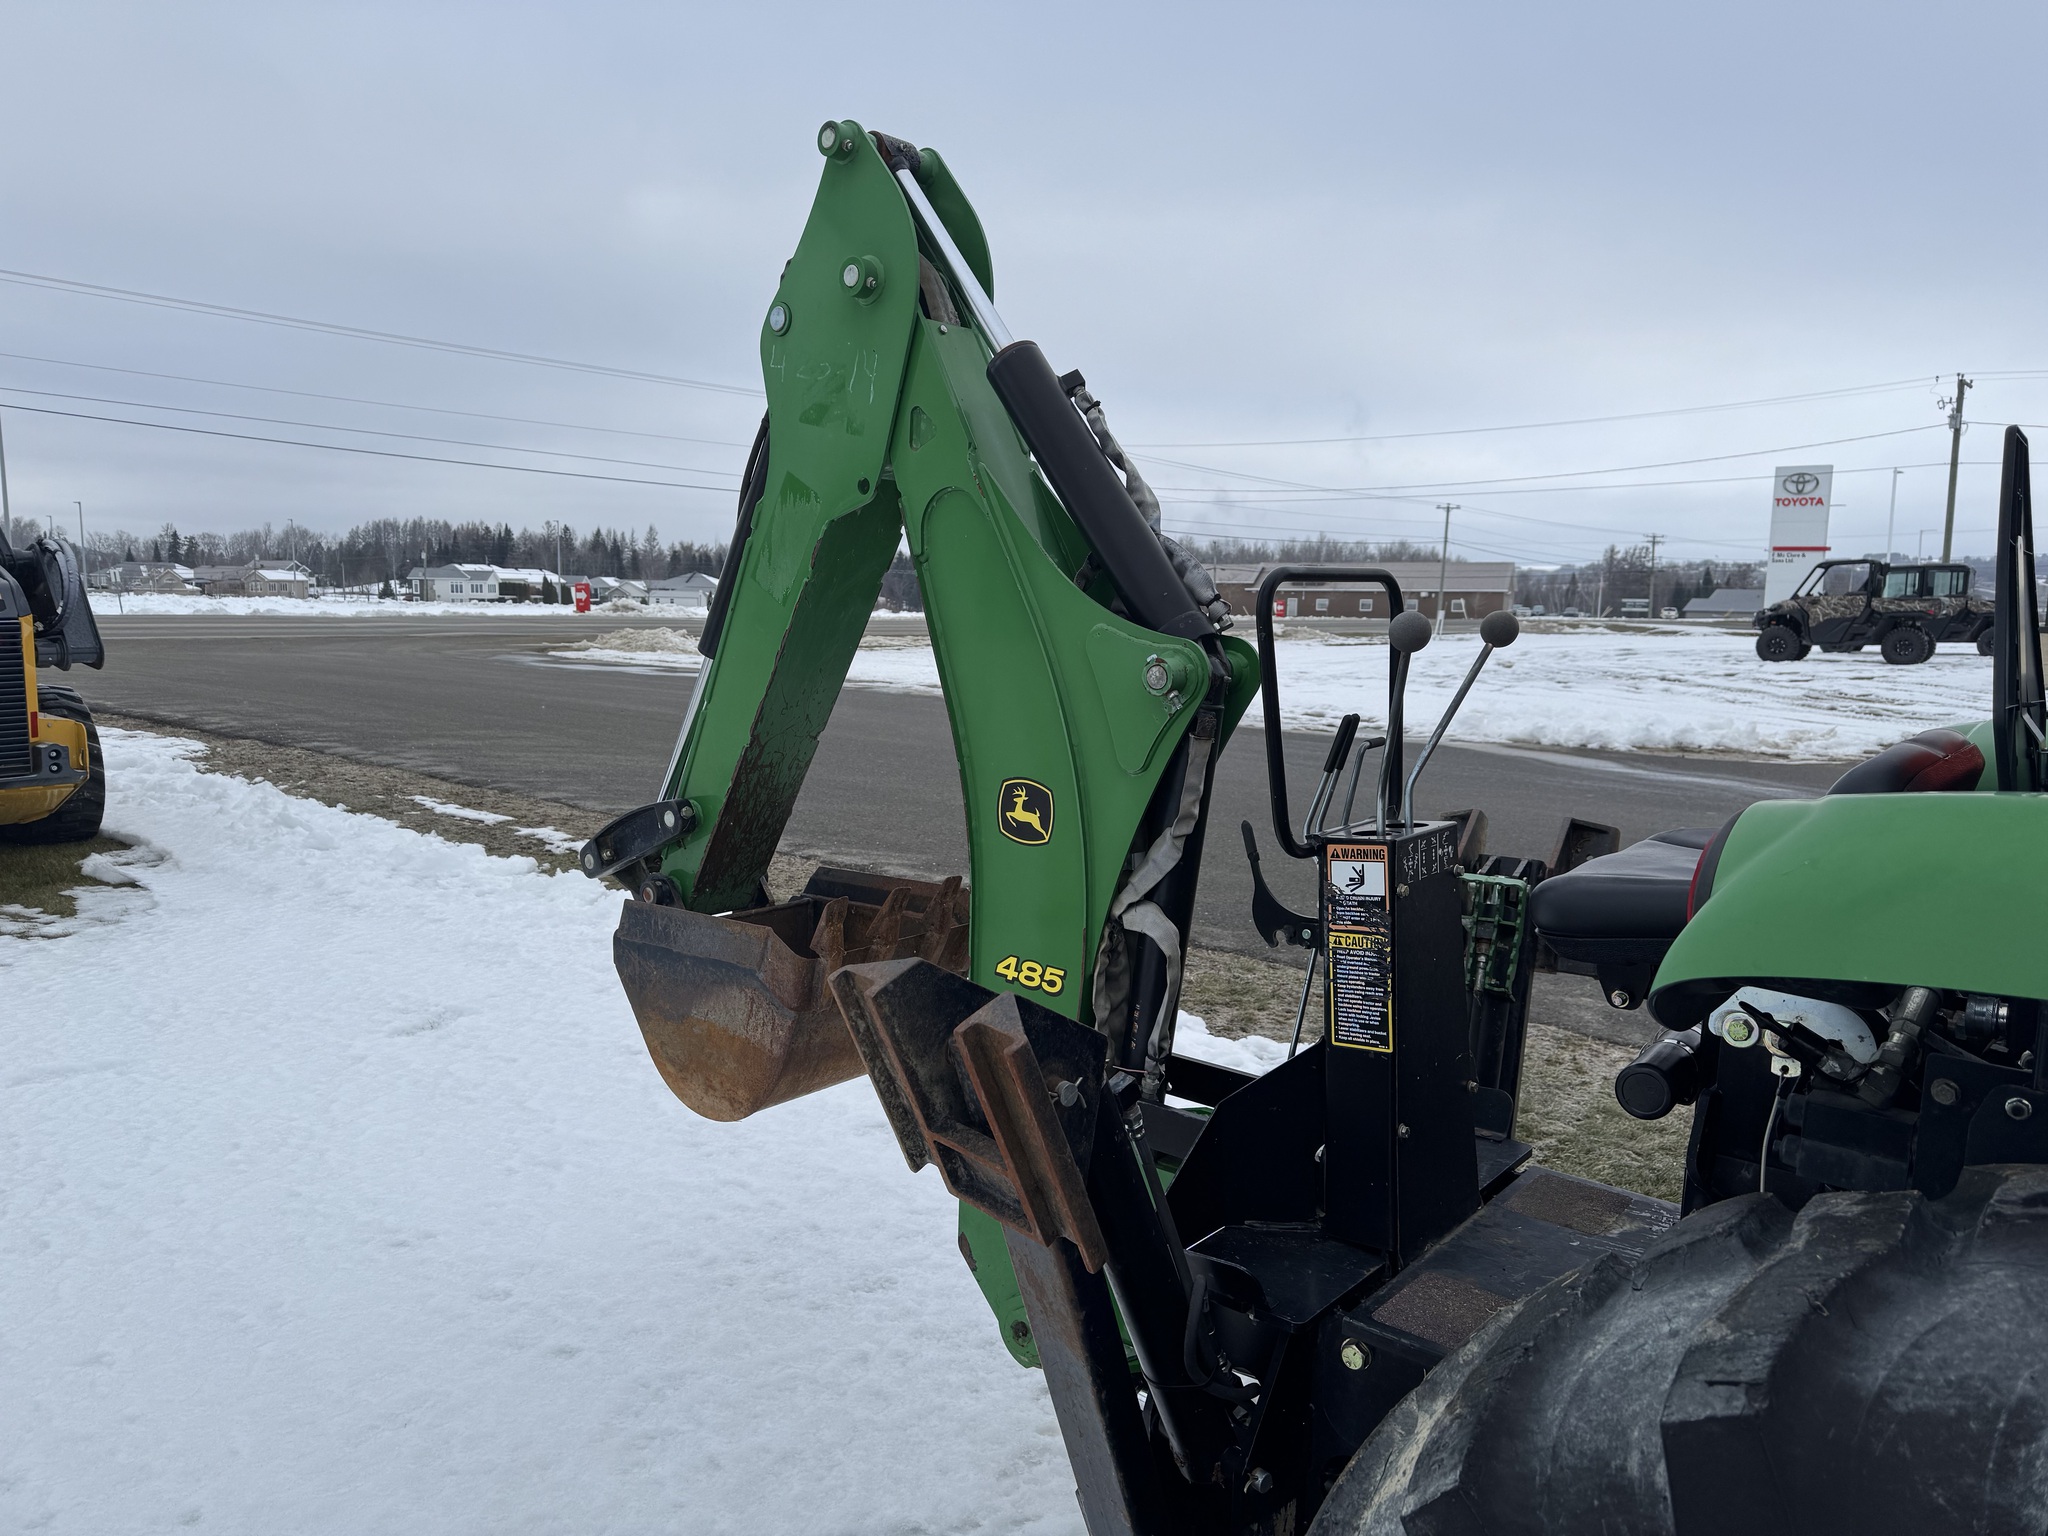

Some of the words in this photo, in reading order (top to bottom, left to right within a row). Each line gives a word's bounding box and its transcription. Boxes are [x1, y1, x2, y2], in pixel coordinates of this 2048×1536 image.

[1775, 497, 1824, 507] TOYOTA
[1341, 848, 1385, 860] WARNING
[995, 955, 1067, 996] 485
